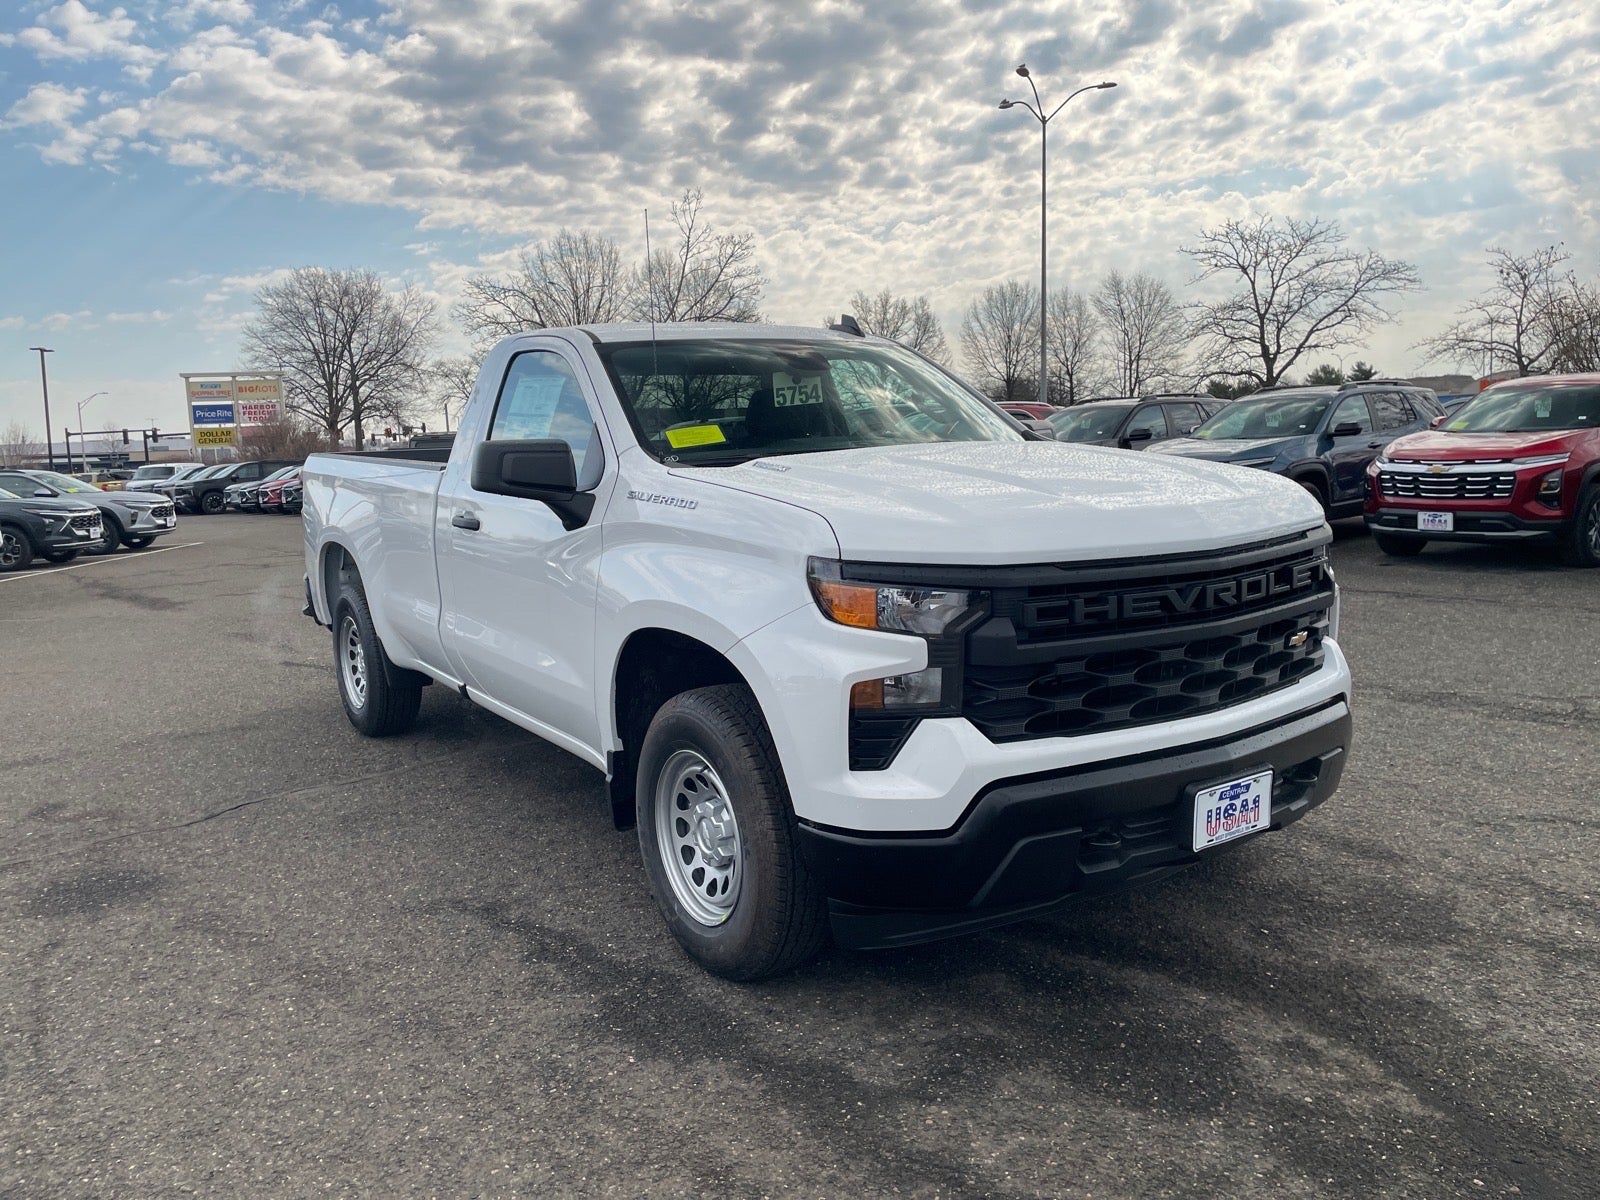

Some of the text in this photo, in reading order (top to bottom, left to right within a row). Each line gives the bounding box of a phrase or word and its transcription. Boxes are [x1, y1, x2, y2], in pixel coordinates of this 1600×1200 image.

[775, 383, 821, 406] 5754
[196, 409, 232, 417] Price Rite
[627, 490, 699, 510] SILVERADO
[1023, 556, 1329, 627] CHEVROLET
[1222, 785, 1248, 799] CENTRAL
